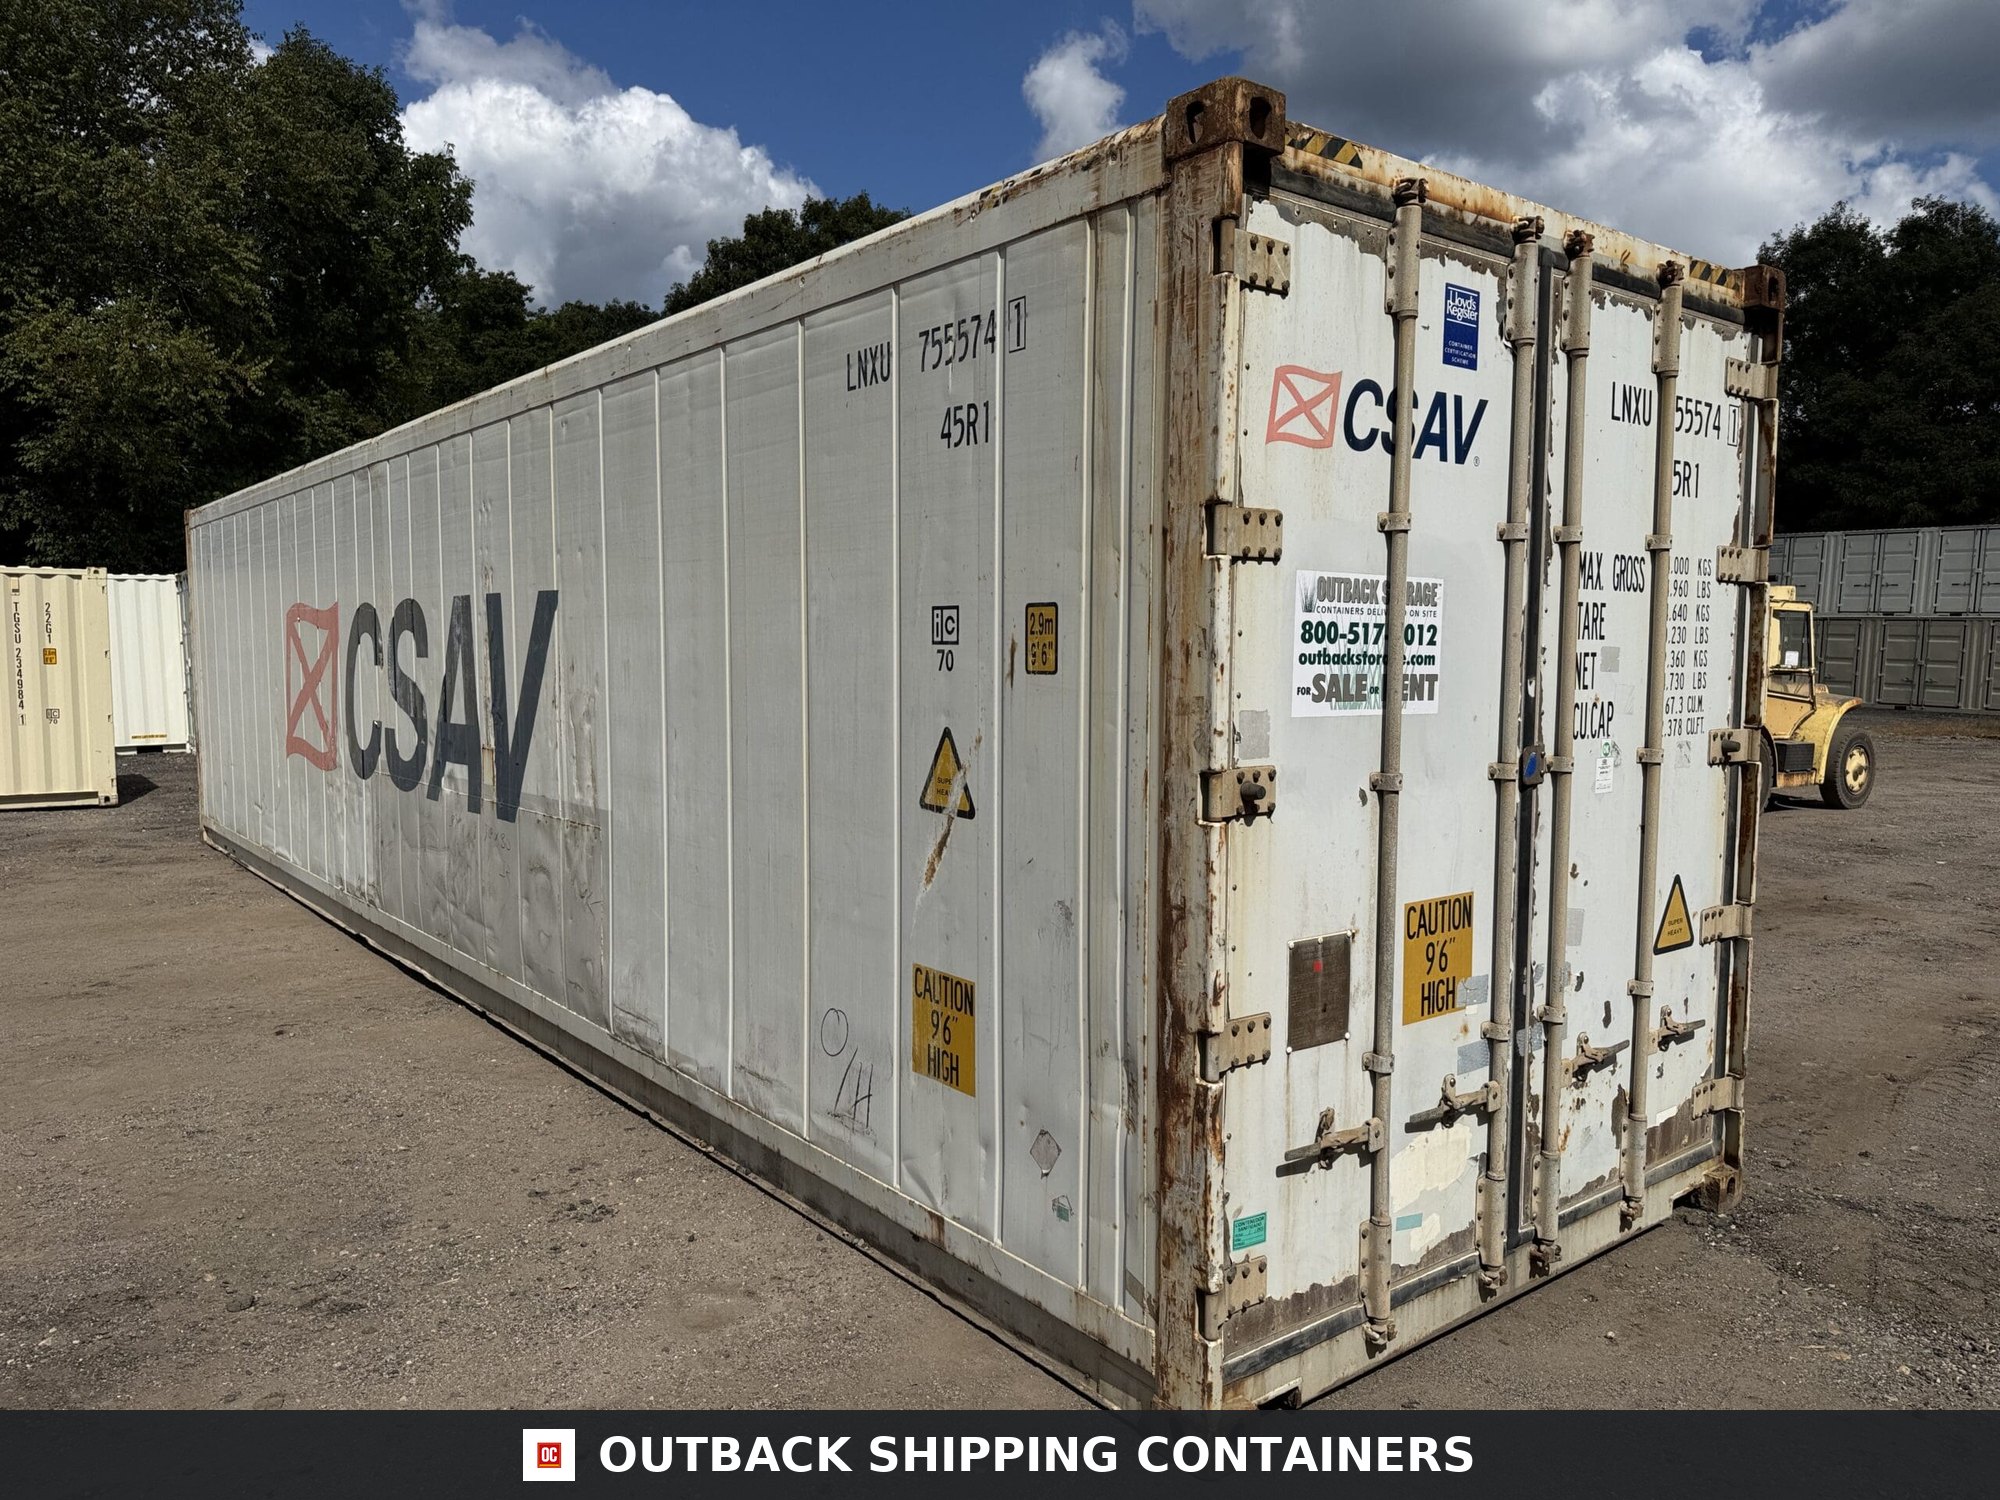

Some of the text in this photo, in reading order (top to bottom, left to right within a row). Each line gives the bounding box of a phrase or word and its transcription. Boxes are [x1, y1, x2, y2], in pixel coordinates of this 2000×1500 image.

[1446, 300, 1478, 321] Register
[846, 341, 891, 392] LNXU
[918, 309, 996, 373] 755574
[1448, 340, 1473, 351] CONTAINER
[940, 400, 990, 449] 45R1
[1343, 378, 1489, 465] CSAV
[1611, 381, 1653, 426] LNXU
[1675, 395, 1722, 440] 55574
[1673, 459, 1700, 499] 5R1
[1612, 553, 1646, 593] GROSS
[1697, 558, 1712, 576] KGS
[1316, 576, 1438, 607] OUTBACK SRAGE
[1696, 580, 1711, 599] LBS
[13, 601, 22, 644] TGSU
[1029, 612, 1054, 635] 2.9m
[1316, 605, 1364, 616] CONTAINERS
[1409, 609, 1420, 617] ON
[1422, 610, 1437, 618] SITE
[1577, 602, 1607, 640] TARE
[1696, 603, 1710, 622] KGS
[1300, 620, 1438, 646] 800-517-012
[1694, 626, 1709, 645] LBS
[936, 649, 955, 672] 70
[1575, 652, 1598, 690] NET
[1693, 649, 1708, 668] KGS
[1296, 686, 1311, 695] FOR
[1311, 673, 1368, 703] SALE
[1369, 686, 1380, 695] OR
[1692, 672, 1707, 690] LBS
[345, 590, 559, 824] CSAV
[1406, 894, 1473, 941] CAUTION
[1667, 917, 1684, 927] SUPER
[1667, 927, 1683, 937] HEAVY
[913, 966, 975, 1017] CAUTION
[1420, 975, 1457, 1018] HIGH
[927, 1043, 960, 1087] HIGH
